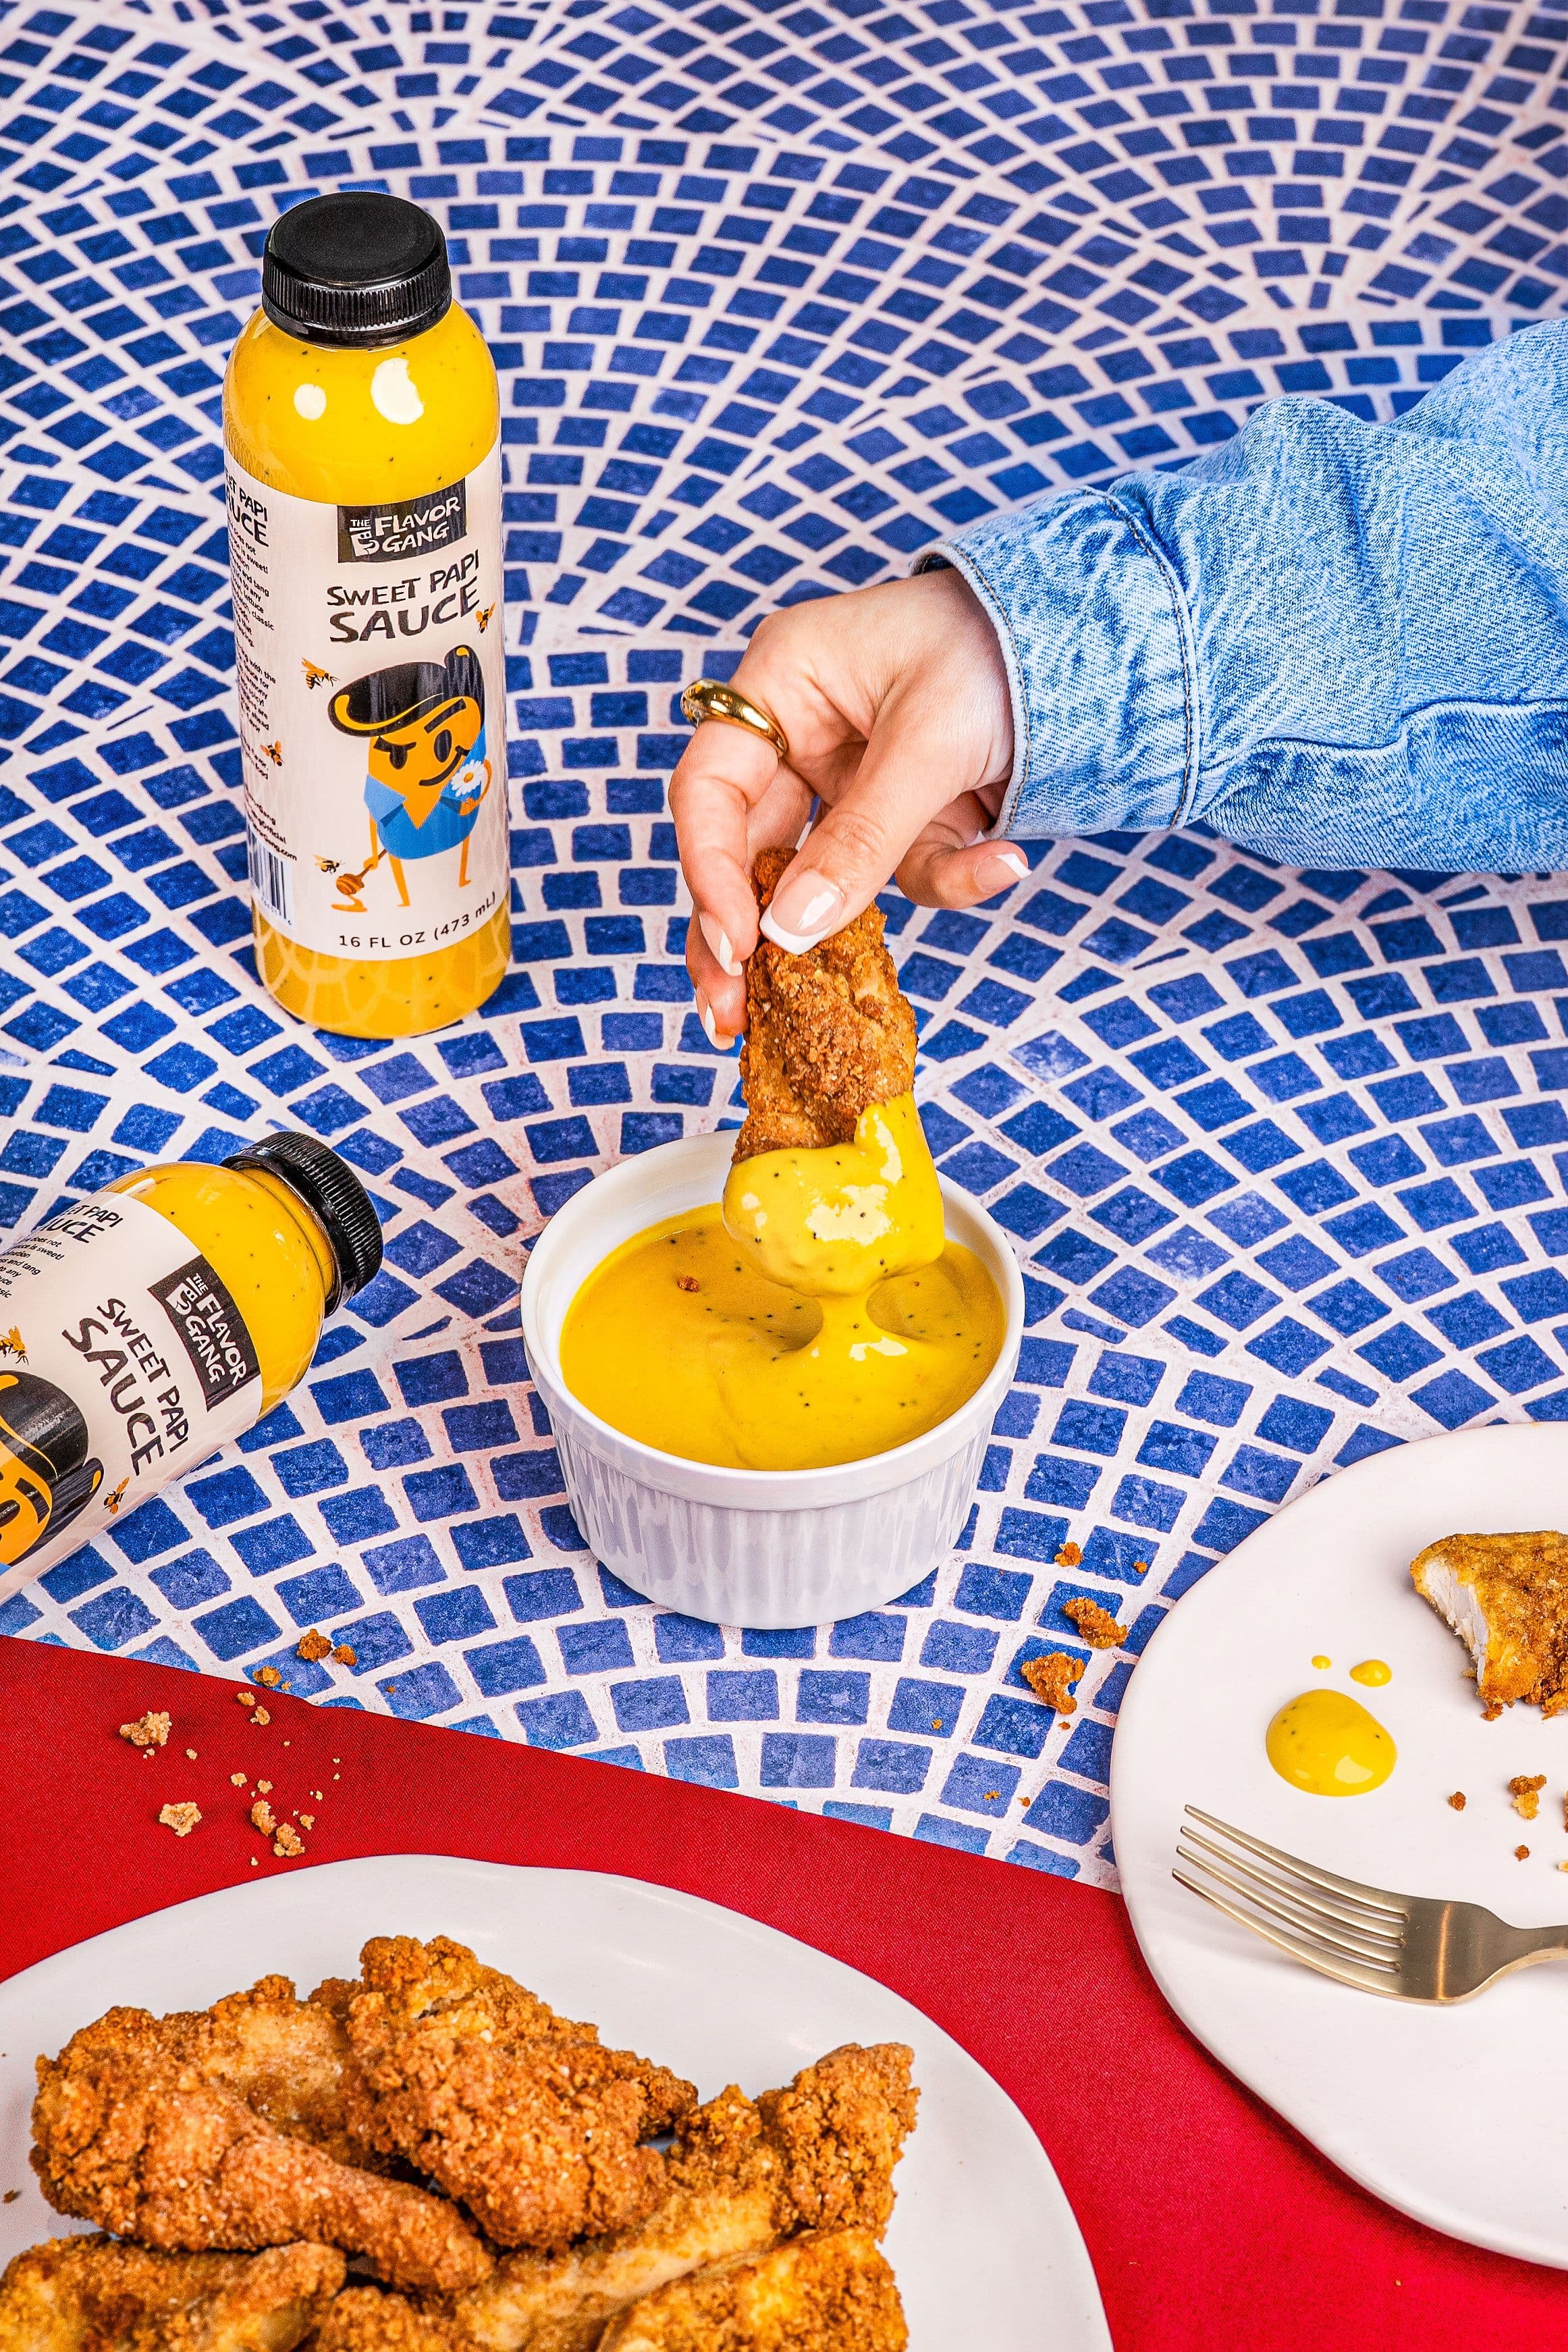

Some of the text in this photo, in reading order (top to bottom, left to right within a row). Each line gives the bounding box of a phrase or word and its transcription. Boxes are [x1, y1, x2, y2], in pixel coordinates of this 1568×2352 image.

[239, 486, 268, 522] PAPI
[350, 496, 461, 536] THE FLAVOR
[381, 521, 450, 553] GANG
[327, 549, 480, 606] SWEET PAPI
[329, 576, 480, 643] SAUCE
[339, 890, 496, 948] 16 FL OZ (473 mL)
[83, 1206, 124, 1228] PAPI
[36, 1246, 65, 1261] sweet!
[47, 1239, 62, 1248] not
[6, 1269, 22, 1278] any
[22, 1262, 41, 1275] tang
[185, 1315, 225, 1384] GANG
[192, 1273, 247, 1386] THE FLAVOR
[96, 1298, 190, 1453] SWEET PAPI
[61, 1317, 165, 1476] SAUCE
